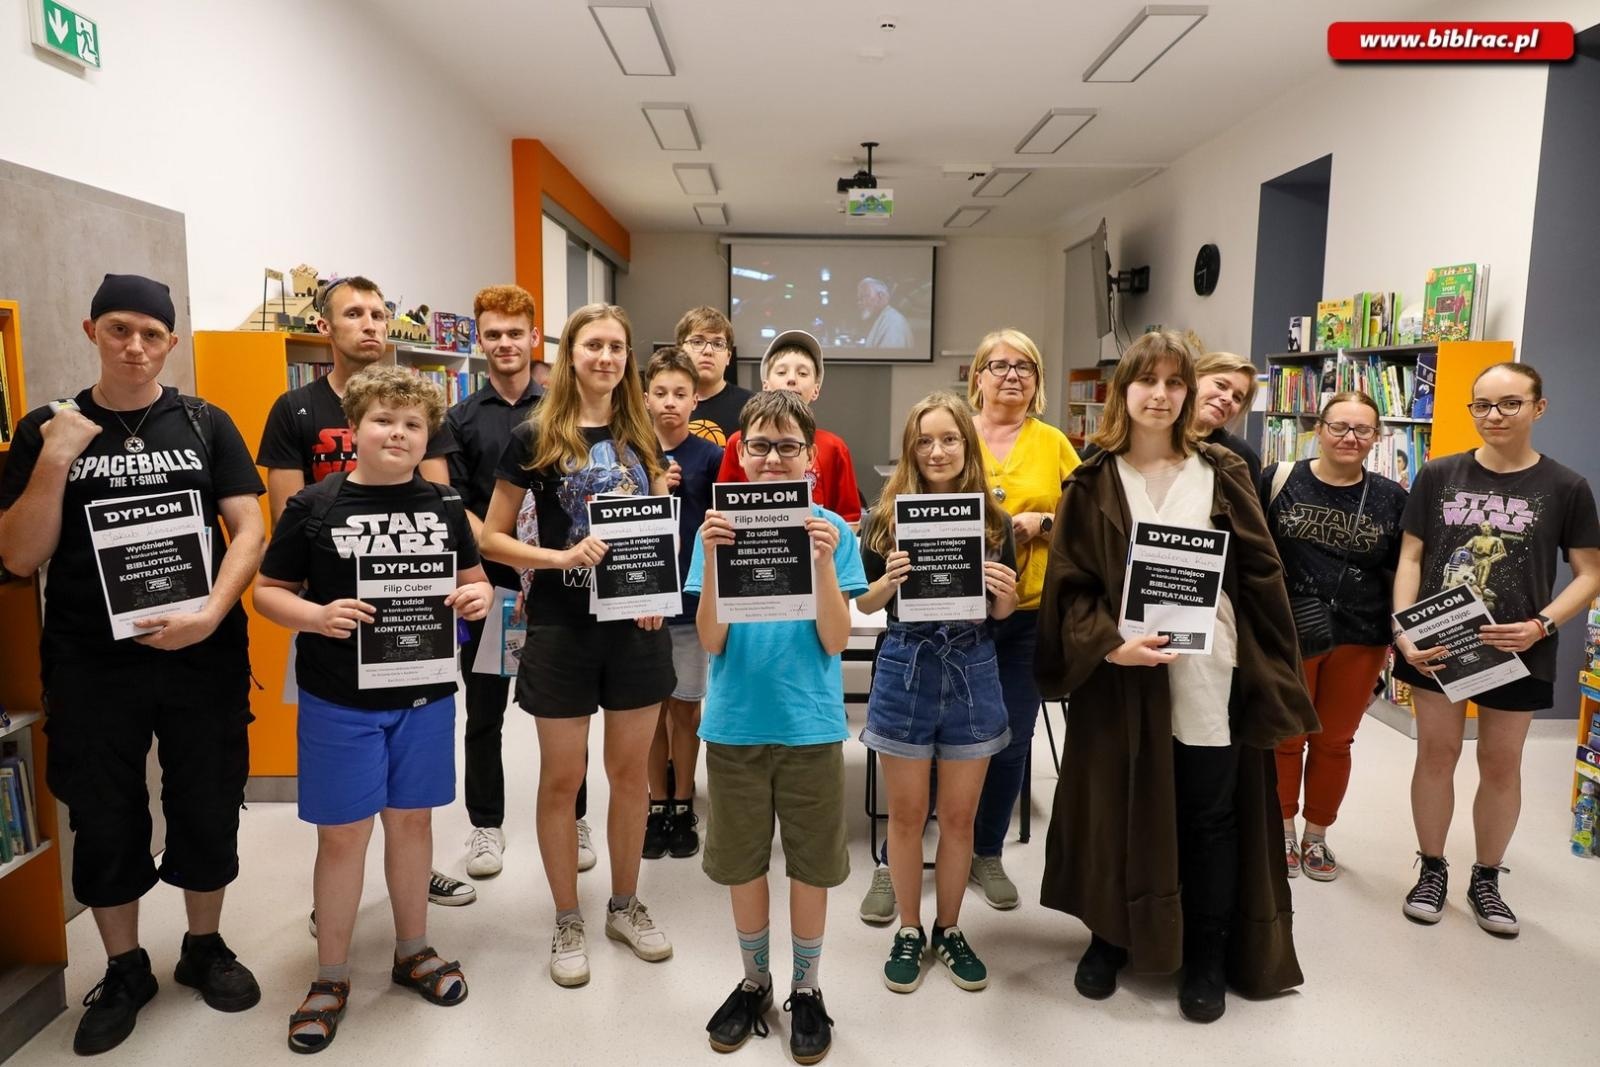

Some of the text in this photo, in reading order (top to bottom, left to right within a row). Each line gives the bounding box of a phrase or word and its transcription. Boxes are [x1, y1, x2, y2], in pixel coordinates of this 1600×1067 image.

[69, 449, 202, 482] SPACEBALLS
[110, 473, 168, 487] THE T-SHIRT
[726, 490, 798, 504] DYPLOM
[601, 504, 663, 518] DYPLOM
[908, 505, 971, 518] DYPLOM
[1443, 492, 1534, 518] STAR
[104, 502, 182, 523] DYPLOM
[734, 514, 789, 525] Filip Molęda
[1280, 503, 1378, 533] STAR
[331, 512, 448, 536] STAR
[1443, 508, 1532, 533] WARS
[635, 537, 660, 546] miejsca
[1148, 531, 1215, 549] DYPLOM
[1279, 518, 1378, 552] WARS
[126, 539, 174, 553] Wyróżnienie
[332, 531, 448, 558] WARS
[940, 539, 966, 547] miejsca
[131, 550, 158, 559] konkursie
[159, 547, 178, 556] wiedzy
[612, 552, 658, 561] BIBLIOTEKA
[738, 546, 790, 555] BIBLIOTEKA
[126, 555, 182, 570] BIBLIOTEKA
[372, 562, 444, 574] DYPLOM
[606, 560, 665, 571] KONTRATAKUJE
[730, 556, 798, 566] KONTRATAKUJE
[912, 563, 970, 572] KONTRATAKUJE
[120, 563, 192, 582] KONTRATAKUJE
[1178, 569, 1205, 579] miejsca
[384, 584, 402, 594] Filip
[1149, 580, 1197, 593] BIBLIOTEKA
[1141, 588, 1204, 604] KONTRATAKUJE
[1407, 593, 1465, 623] DYPLOM
[383, 614, 434, 622] BIBLIOTEKA
[1419, 610, 1471, 634] Roksana Zając
[374, 623, 442, 633] KONTRATAKUJE
[1446, 624, 1464, 635] udział
